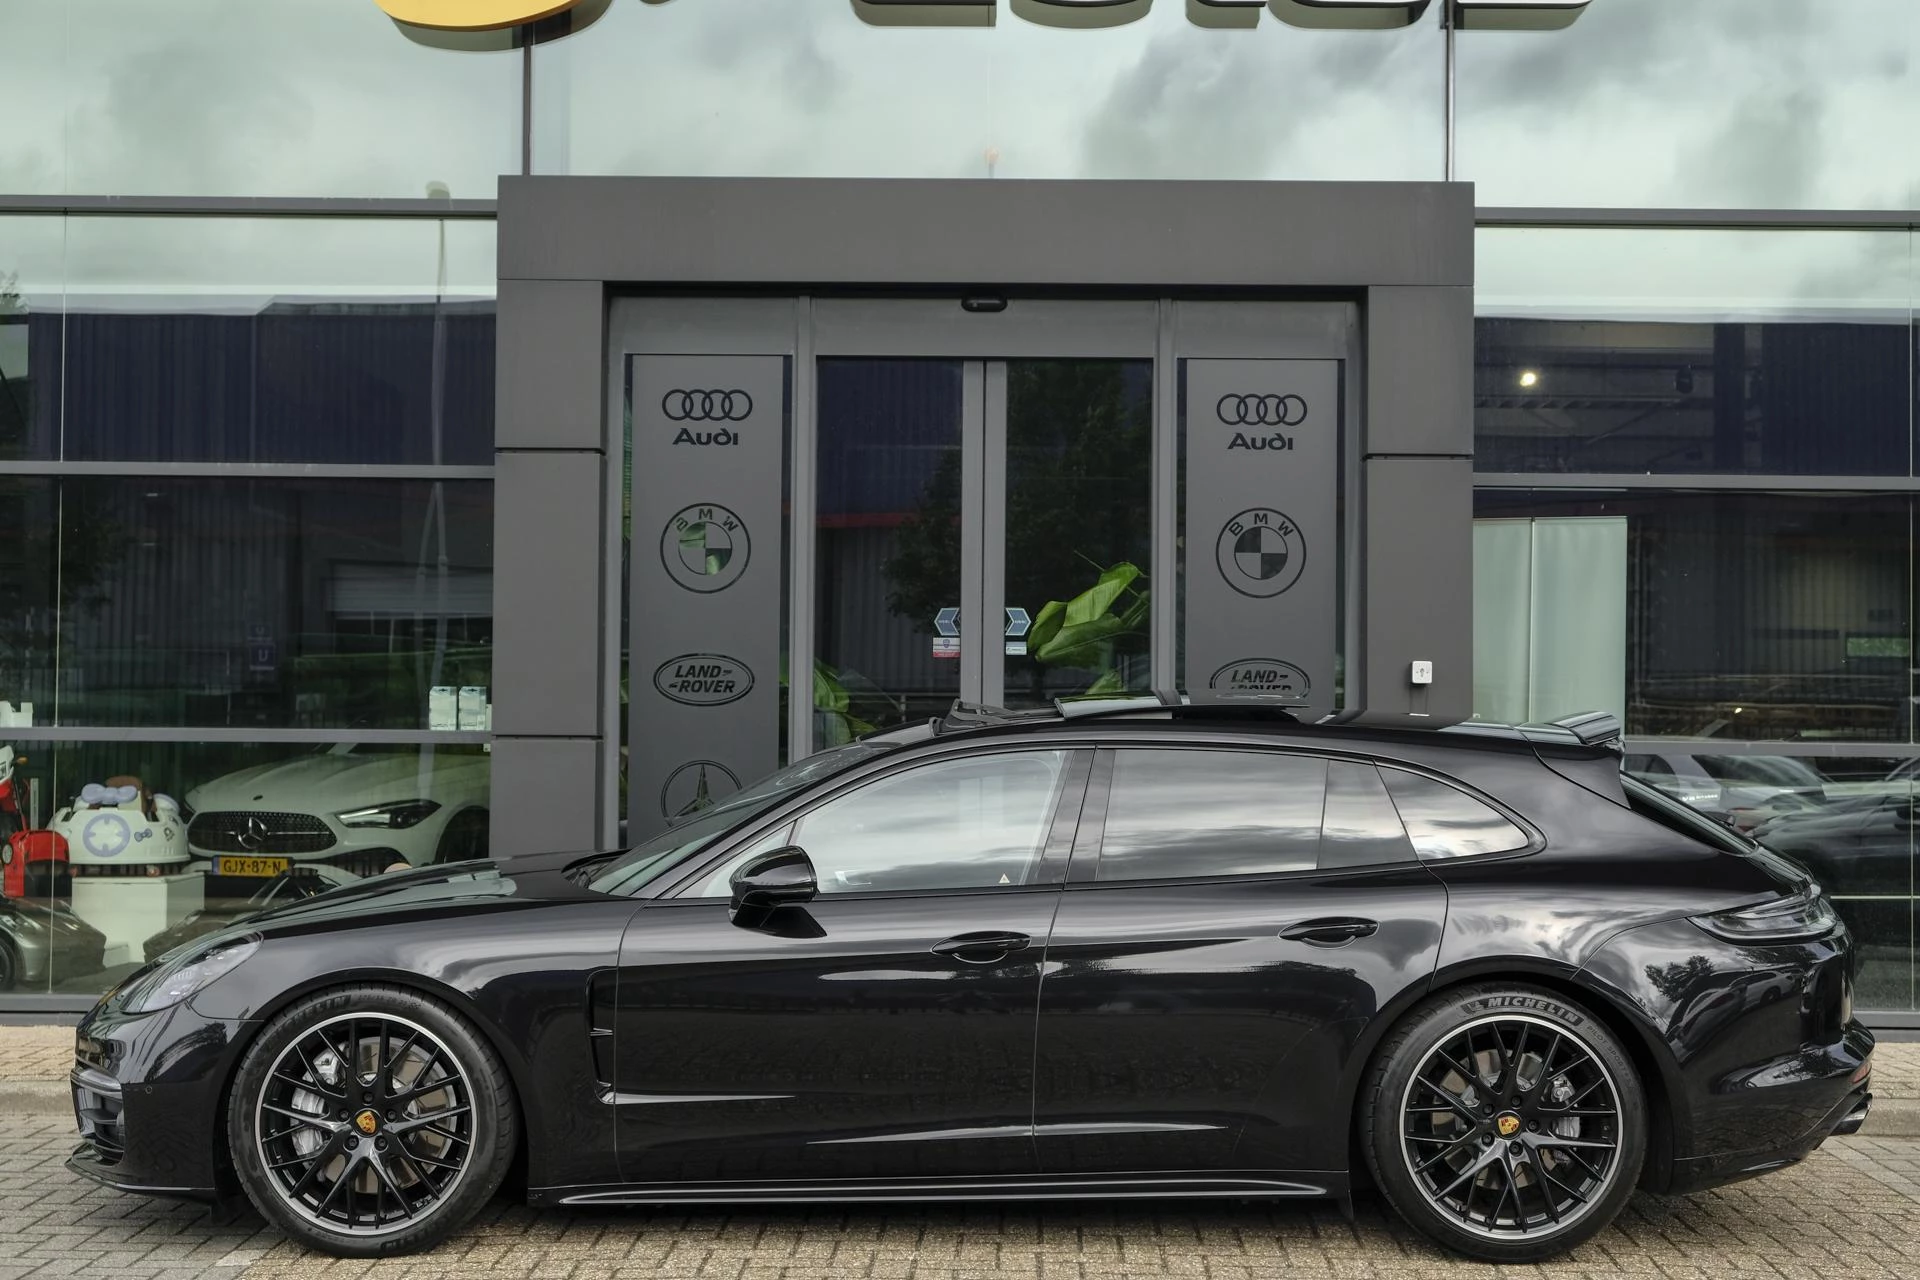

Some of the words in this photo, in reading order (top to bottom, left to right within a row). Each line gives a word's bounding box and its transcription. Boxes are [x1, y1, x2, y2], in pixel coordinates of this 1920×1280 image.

[672, 427, 739, 446] Audi
[1227, 432, 1294, 450] Audi
[675, 508, 739, 533] BMW
[1228, 513, 1294, 537] BMW
[675, 665, 722, 678] LAND
[677, 680, 736, 693] ROVER
[223, 860, 281, 874] GJX-87-N
[1487, 996, 1579, 1025] MICHELIN
